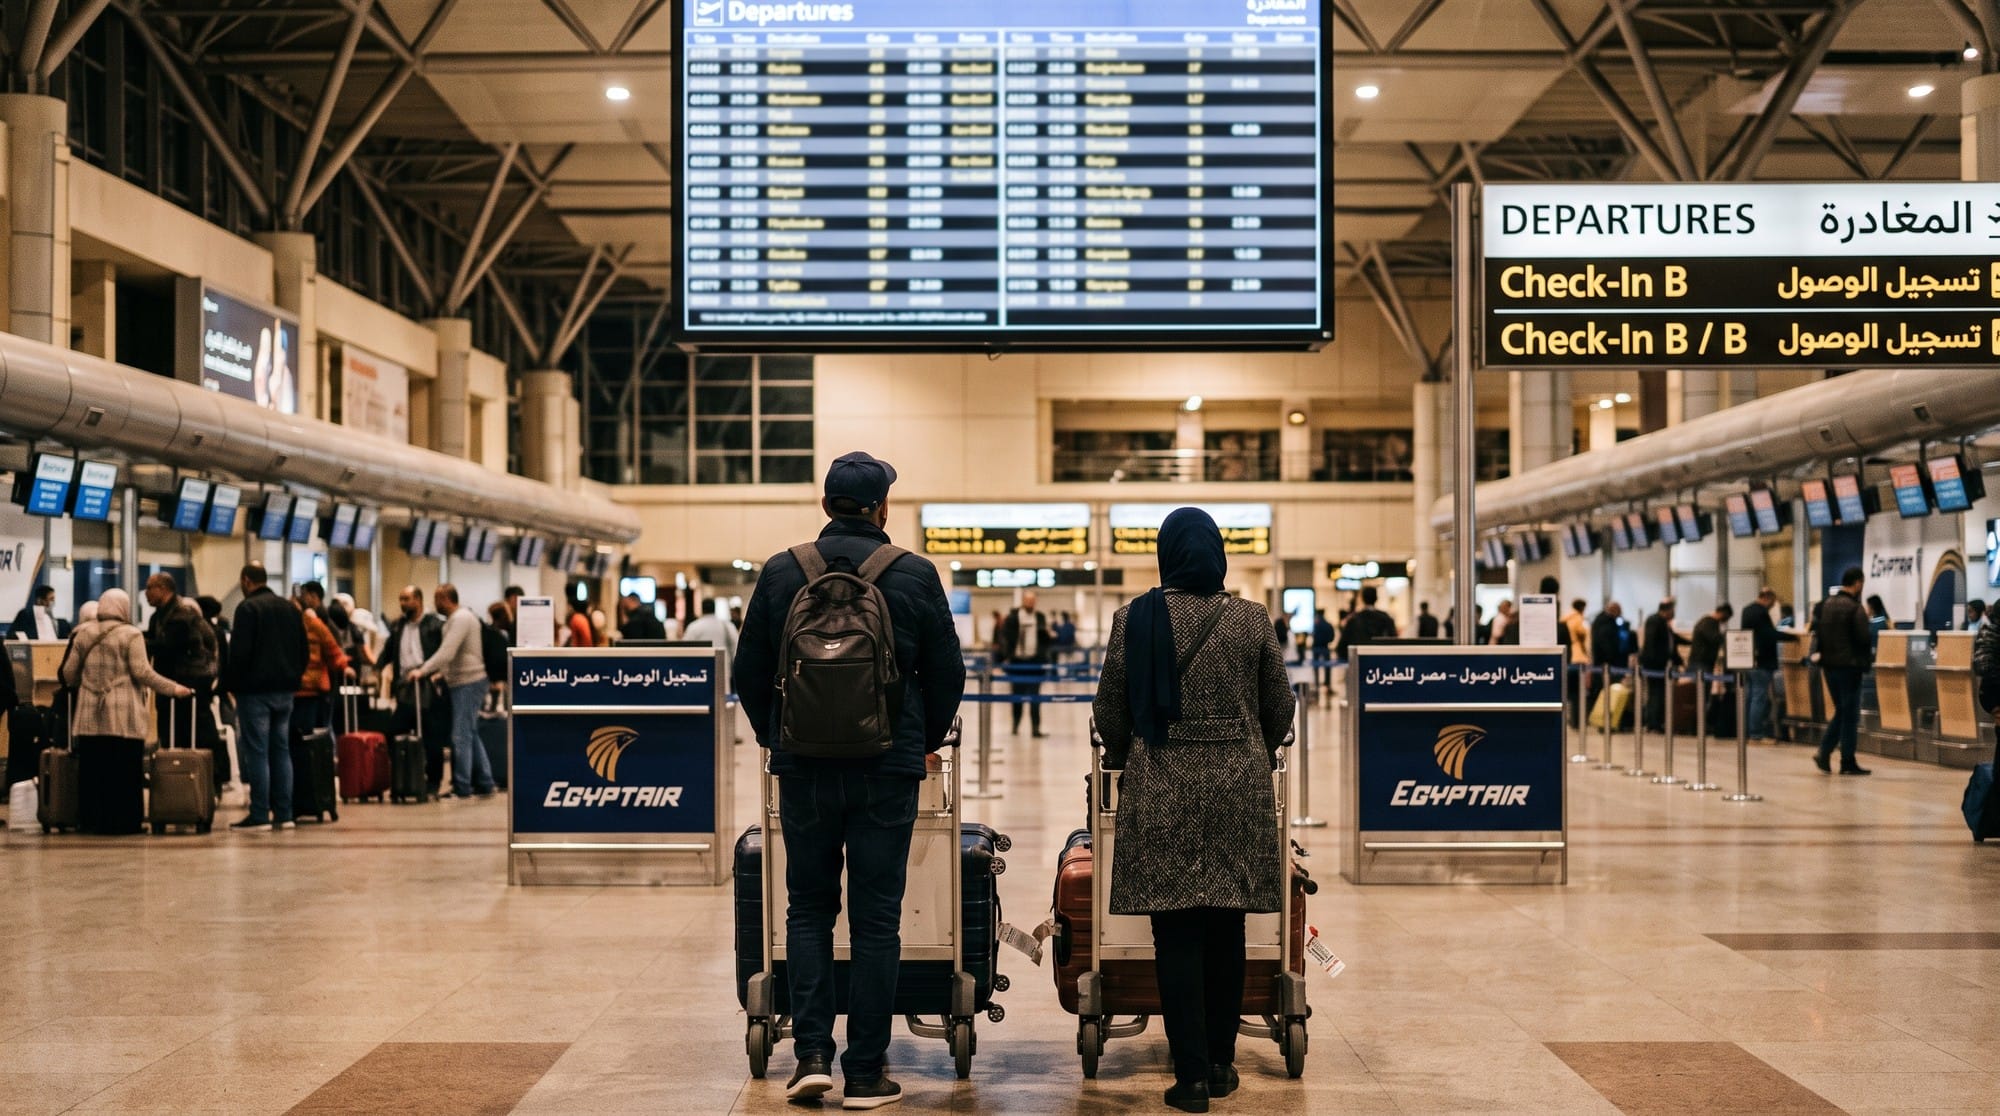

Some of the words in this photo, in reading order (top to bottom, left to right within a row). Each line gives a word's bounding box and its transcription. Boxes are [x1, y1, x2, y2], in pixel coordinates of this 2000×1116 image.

[728, 0, 854, 26] Departures
[1502, 203, 1755, 235] DEPARTURES
[1819, 200, 1972, 244] المغادرة
[1500, 264, 1653, 299] Check-In
[1664, 265, 1688, 298] B
[1777, 266, 1878, 300] الوصول
[1885, 266, 1981, 299] تسجيل
[1500, 321, 1654, 356] Check-In
[1665, 322, 1689, 355] B
[1698, 321, 1714, 356] /
[1724, 322, 1748, 355] B
[1778, 322, 1879, 356] الوصول
[1886, 322, 1982, 356] تسجيل
[519, 668, 568, 687] للطيران
[569, 673, 600, 687] مصر
[612, 668, 660, 687] الوصول
[662, 669, 708, 687] تسجيل
[1365, 666, 1415, 685] للطيران
[1416, 671, 1447, 685] مصر
[1459, 666, 1507, 685] الوصول
[1510, 667, 1555, 685] تسجيل
[543, 781, 683, 807] EGYPTAIR
[1390, 780, 1530, 806] EGYPTAIR
